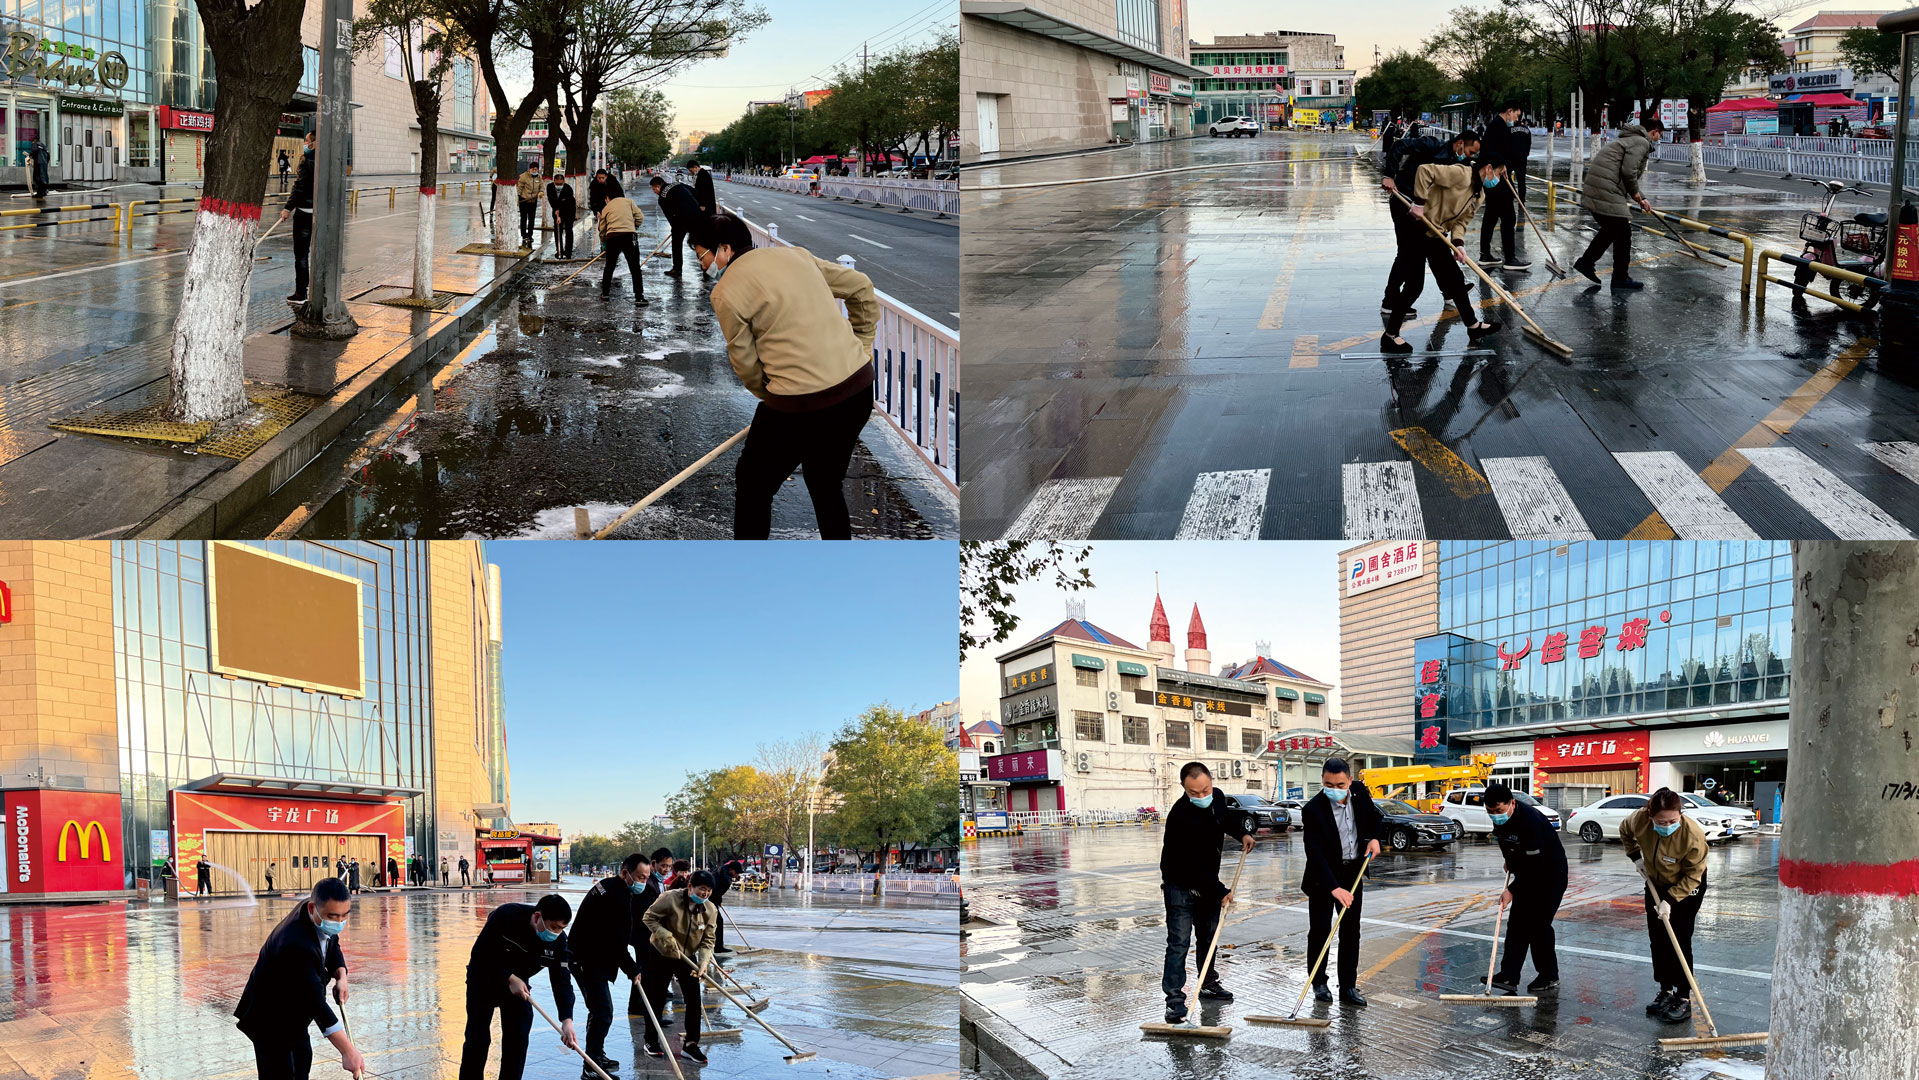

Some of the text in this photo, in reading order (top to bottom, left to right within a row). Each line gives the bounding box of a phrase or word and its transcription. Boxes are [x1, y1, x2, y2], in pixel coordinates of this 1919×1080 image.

[7, 31, 97, 87] Bravo
[61, 99, 91, 111] Entrance
[99, 104, 111, 112] Exit
[180, 114, 213, 128] 正新鸡排
[1540, 617, 1651, 665] 佳客来
[1420, 659, 1441, 749] 佳客来
[1727, 733, 1769, 744] HUAWEI
[1557, 740, 1617, 757] 宇龙广场
[267, 806, 340, 825] 宇龙广场
[16, 805, 31, 883] McDonald's
